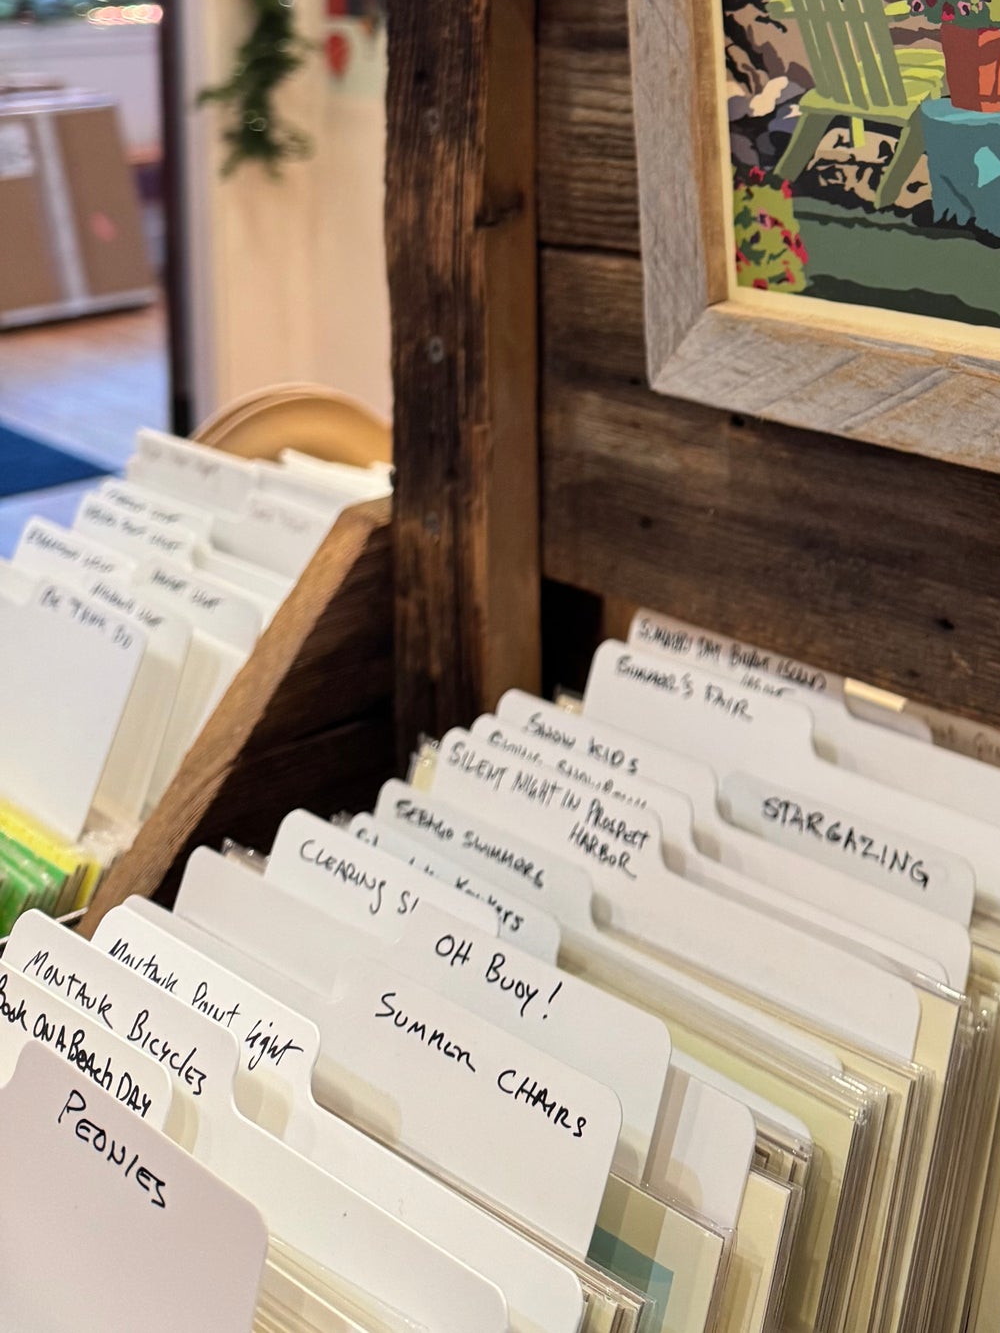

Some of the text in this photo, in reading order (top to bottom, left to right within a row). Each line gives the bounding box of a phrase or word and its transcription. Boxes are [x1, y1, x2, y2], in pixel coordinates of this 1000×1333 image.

[523, 711, 577, 749] SNOW
[588, 736, 640, 775] KIDS
[449, 740, 508, 790] SILENT
[512, 769, 563, 810] NIGHT
[561, 788, 581, 812] IN
[584, 797, 651, 850] PROSPECT
[567, 821, 637, 880] HARBOR
[761, 796, 930, 891] STARGAZING
[435, 933, 474, 967] OH
[115, 1072, 153, 1119] DAY
[497, 1069, 588, 1138] CHAIRS
[57, 1089, 167, 1209] PEONIES
